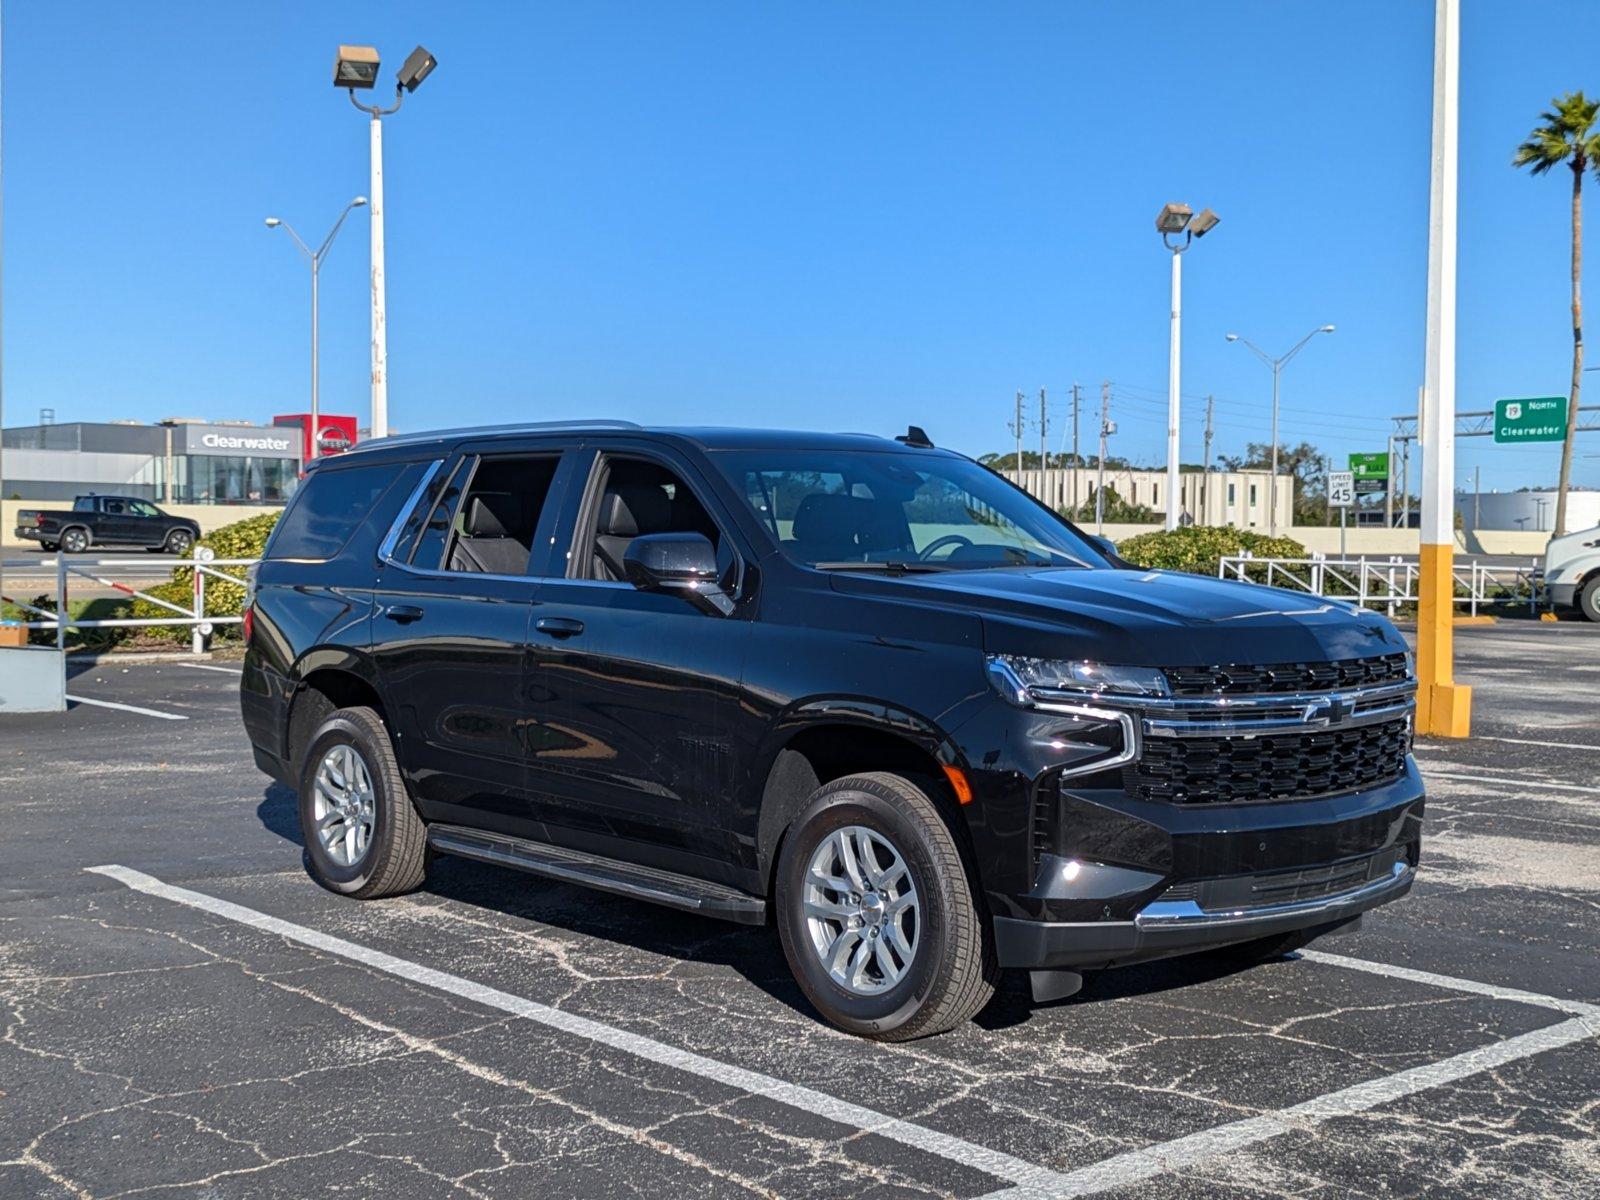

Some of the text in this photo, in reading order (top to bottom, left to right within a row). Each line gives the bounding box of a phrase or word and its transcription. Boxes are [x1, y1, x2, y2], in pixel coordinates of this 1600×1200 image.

[1508, 406, 1518, 416] 19
[1501, 426, 1559, 436] Clearwater
[202, 433, 290, 450] Clearwater
[1331, 489, 1351, 502] 45
